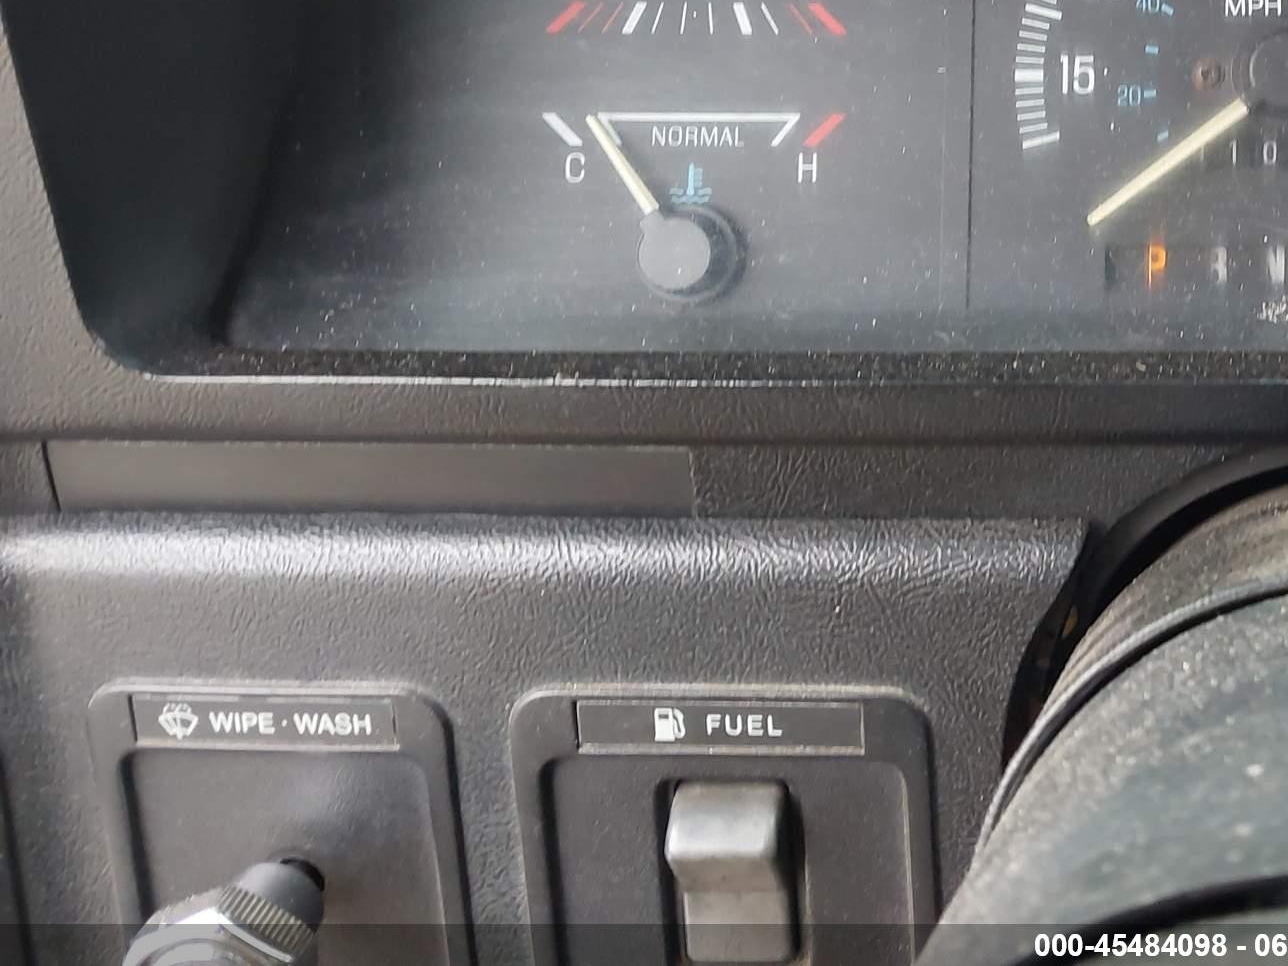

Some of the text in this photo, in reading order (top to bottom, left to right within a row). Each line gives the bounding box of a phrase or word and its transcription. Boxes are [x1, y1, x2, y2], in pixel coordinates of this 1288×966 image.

[1059, 54, 1095, 95] 15
[1116, 85, 1142, 106] 20
[651, 125, 744, 148] NORMAL
[565, 152, 586, 183] C
[797, 151, 818, 183] H
[1146, 245, 1167, 285] P
[208, 711, 373, 736] WIPE WASH
[706, 713, 784, 737] FUEL
